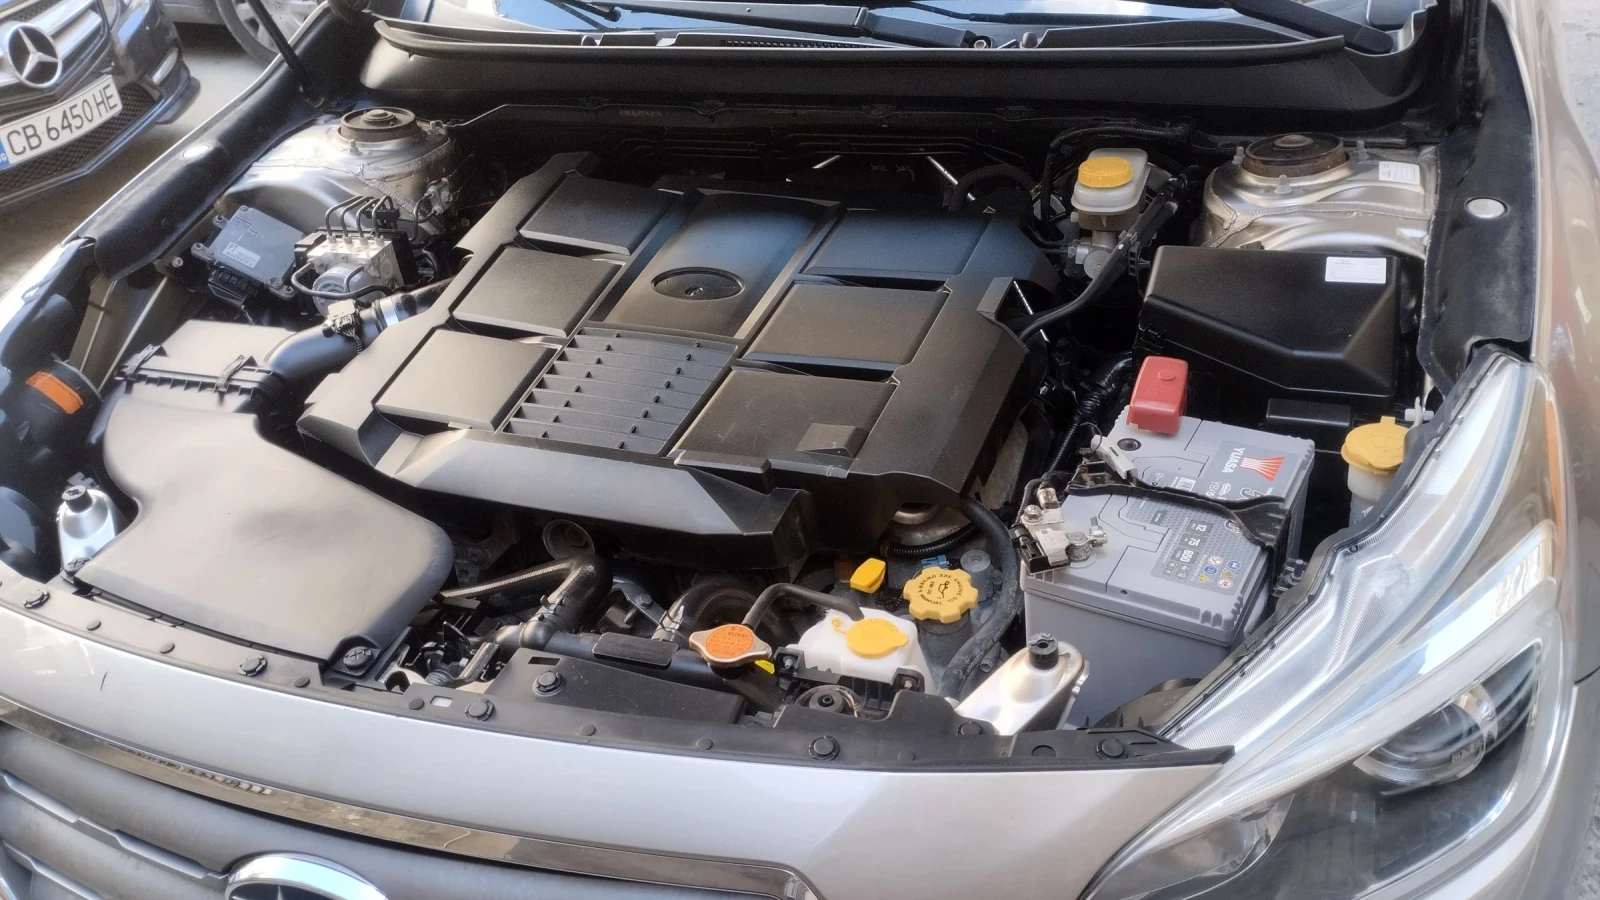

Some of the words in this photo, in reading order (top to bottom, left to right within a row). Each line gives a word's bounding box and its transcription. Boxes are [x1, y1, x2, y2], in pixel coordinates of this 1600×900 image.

[7, 124, 42, 156] CB
[46, 99, 94, 141] 6450
[93, 84, 118, 117] HE
[1222, 447, 1245, 473] YUASA
[1195, 524, 1207, 532] 12
[1188, 537, 1200, 547] 75
[1180, 549, 1194, 563] 650
[920, 594, 943, 605] MANUAL
